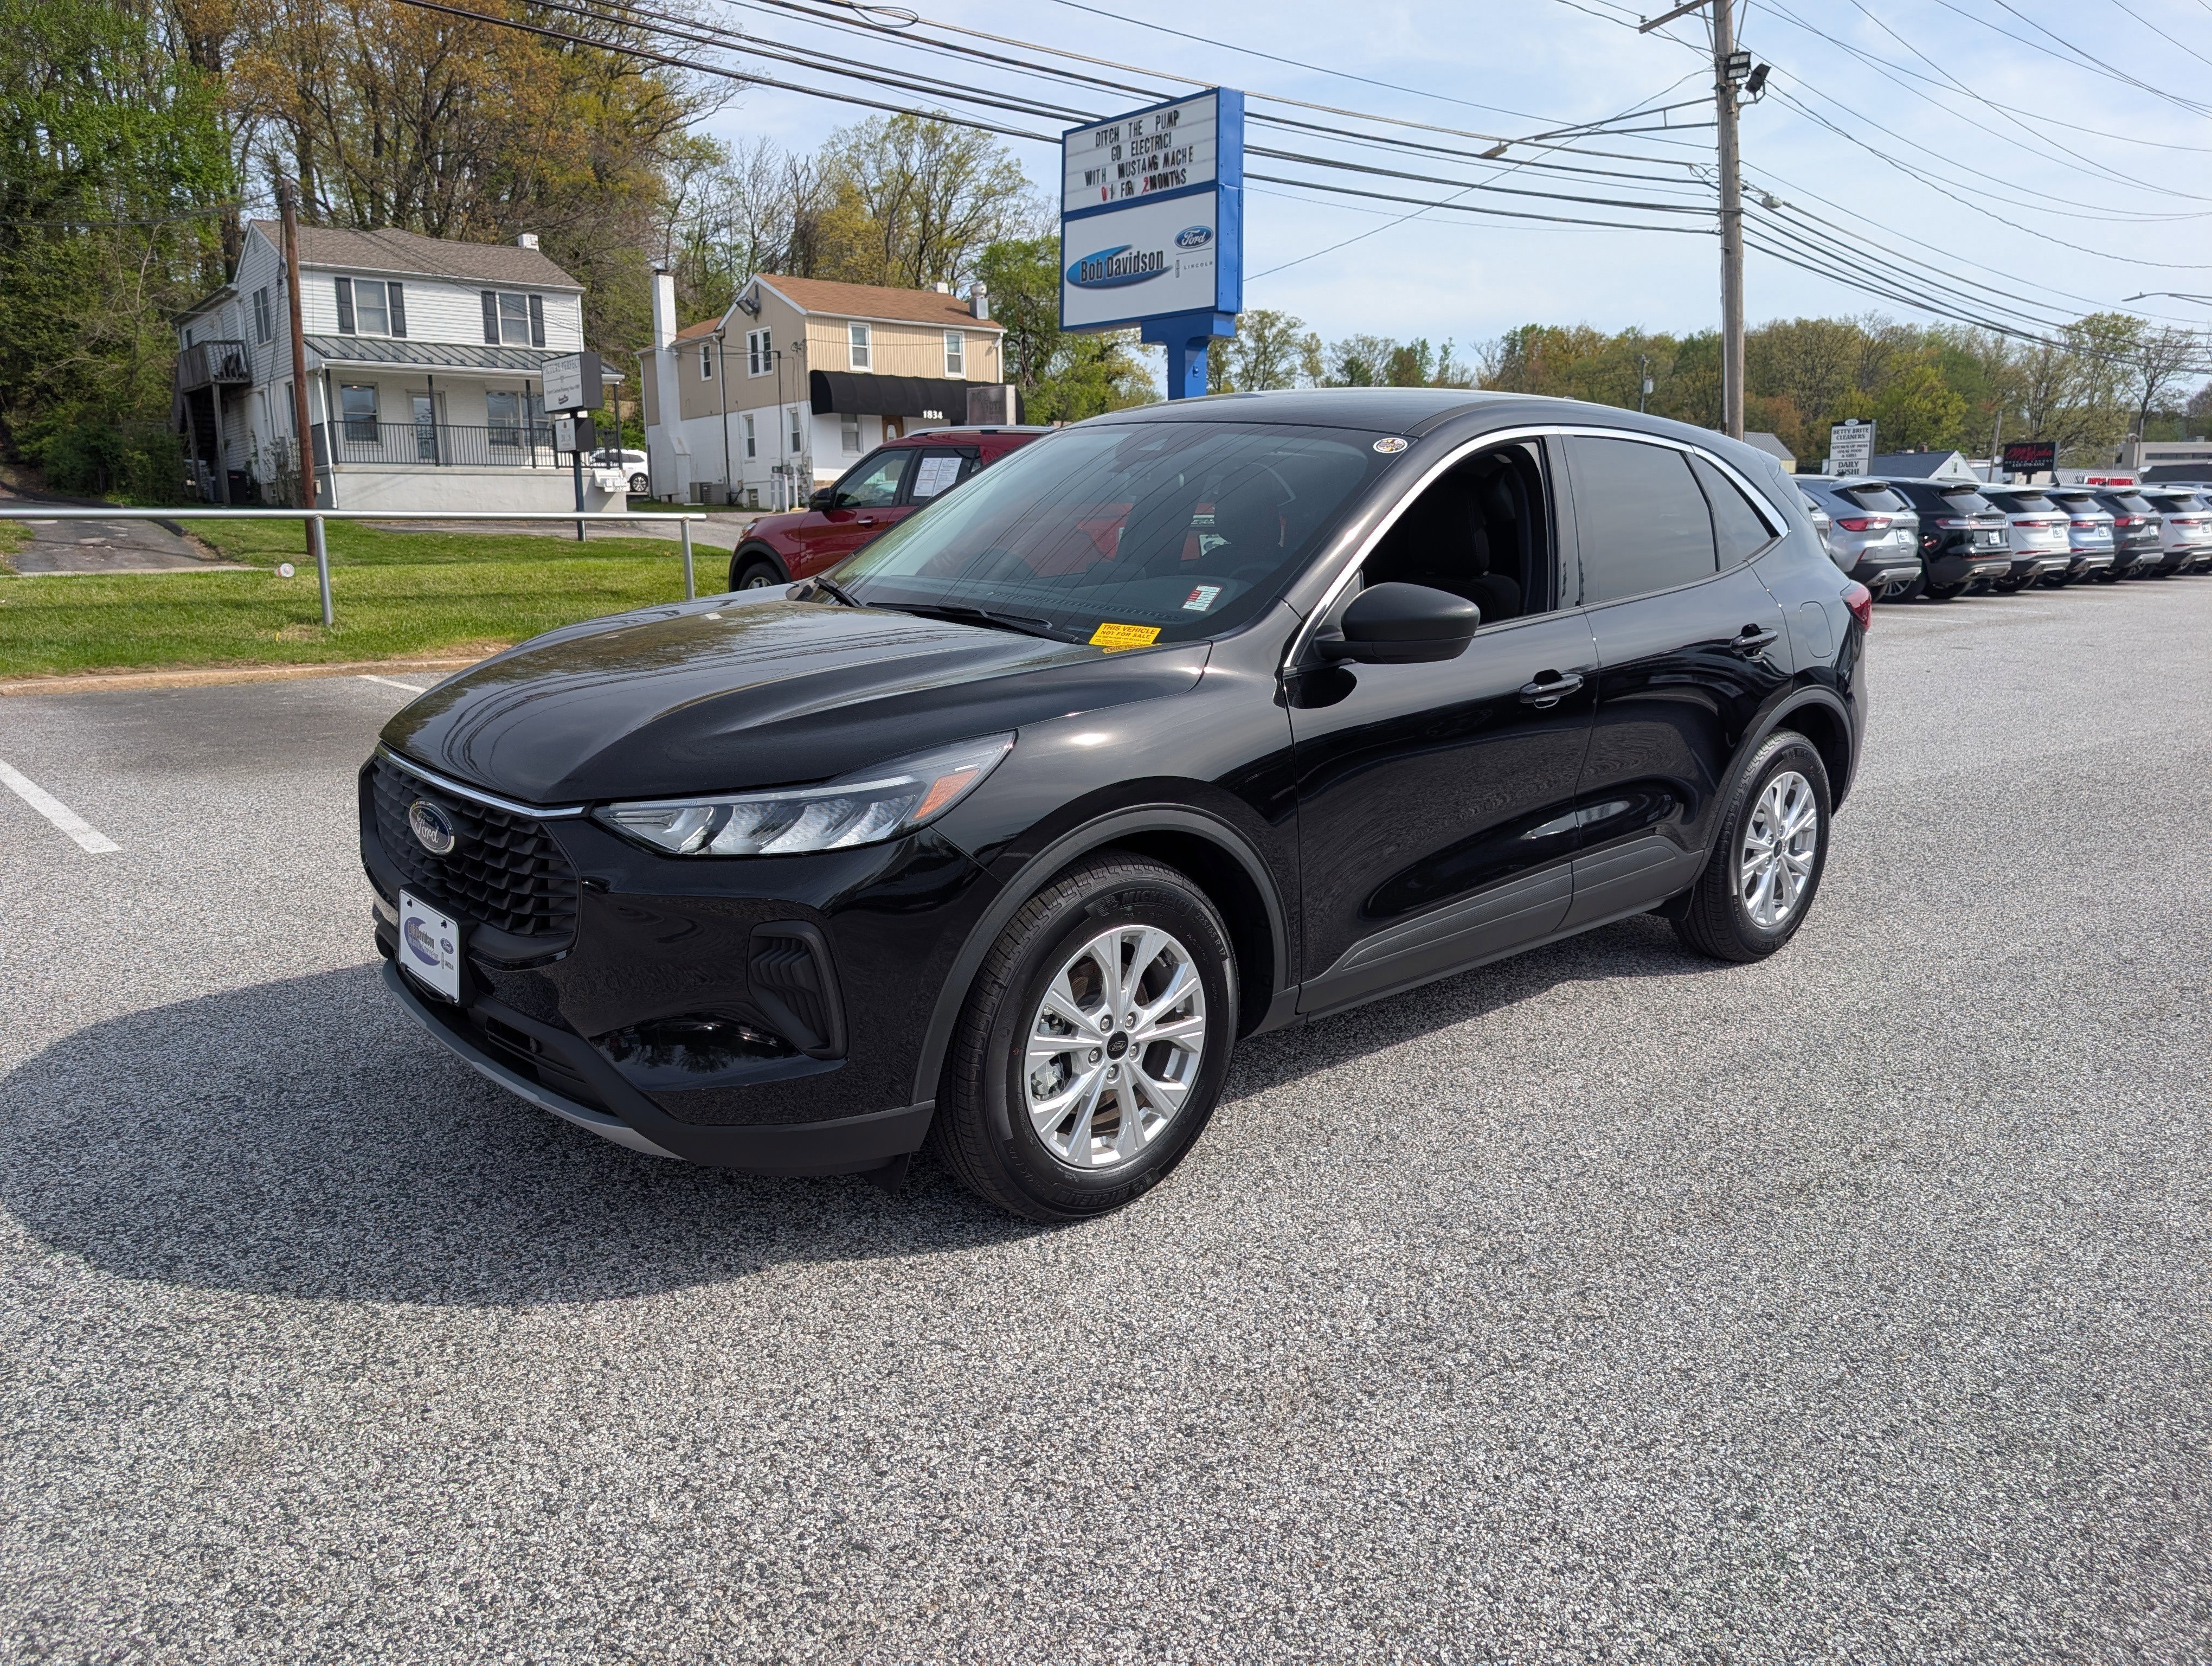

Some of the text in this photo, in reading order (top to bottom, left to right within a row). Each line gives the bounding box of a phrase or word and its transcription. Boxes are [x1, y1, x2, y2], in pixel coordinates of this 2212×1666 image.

[1096, 110, 1179, 148] DITCH THE PUMP
[1111, 132, 1172, 162] GO ELECTRIC!
[1085, 168, 1106, 186] WITH
[1117, 155, 1159, 180] MUSTANG
[1121, 180, 1134, 198] FOR
[1181, 230, 1206, 246] Ford
[1081, 250, 1163, 282] Bob Davidson
[1184, 261, 1213, 270] LINCOLN
[923, 410, 943, 419] 1834
[1123, 625, 1158, 635] VEHICLE
[415, 809, 440, 844] Ford
[1122, 890, 1188, 909] MICHELIN
[1195, 912, 1218, 938] 225/65
[1219, 947, 1226, 956] 17
[1061, 1187, 1129, 1206] MICHELIN
